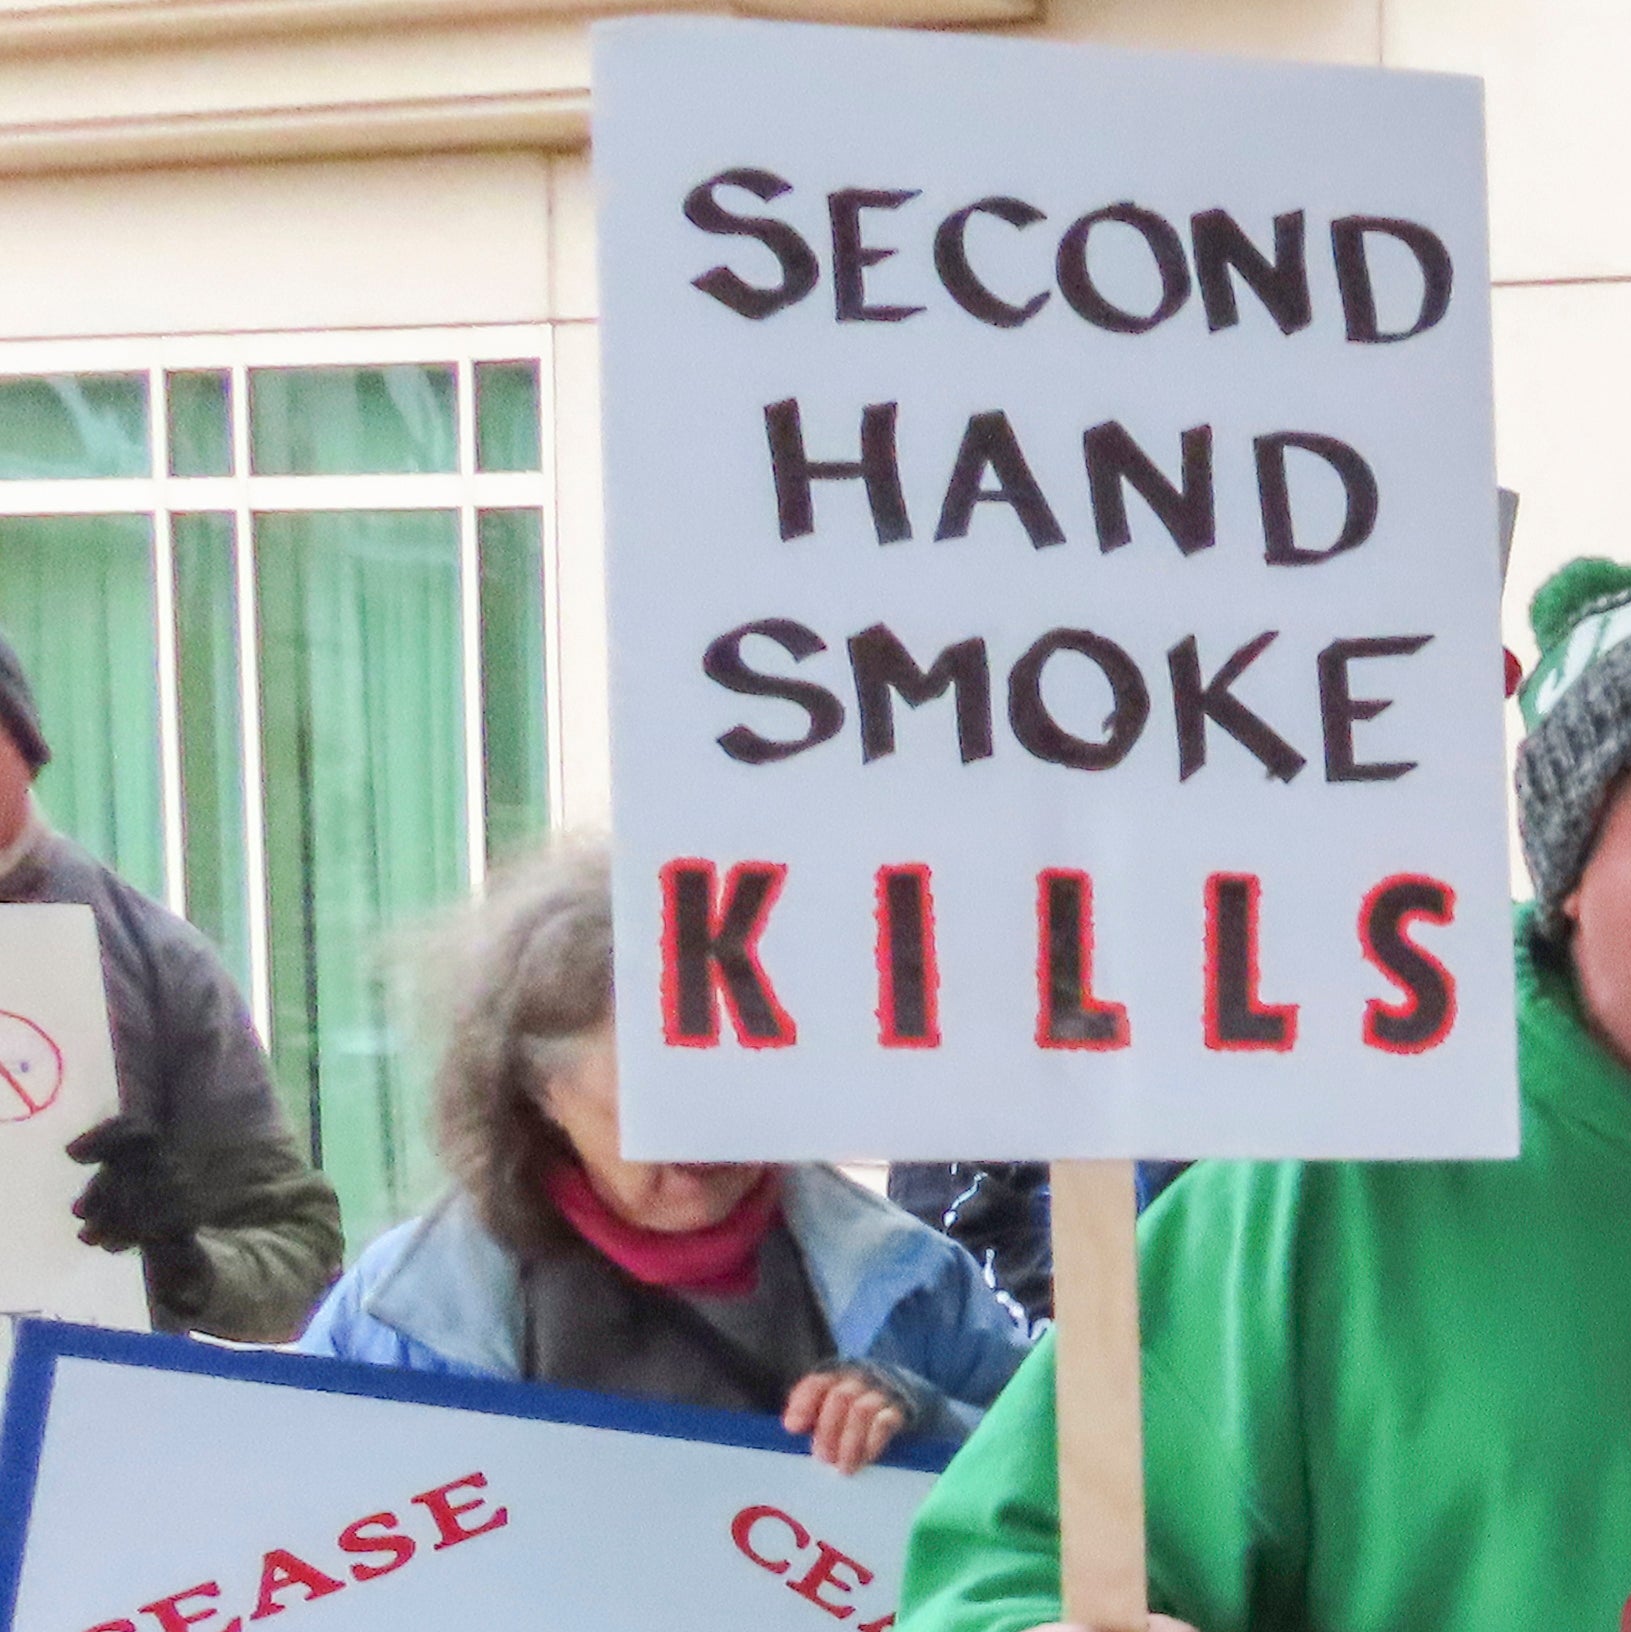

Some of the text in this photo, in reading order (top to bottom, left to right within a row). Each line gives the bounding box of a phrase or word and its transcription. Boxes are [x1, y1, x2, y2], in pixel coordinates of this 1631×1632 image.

[682, 167, 1453, 343] SECOND
[764, 398, 1379, 567] HAND
[702, 618, 1435, 784] SMOKE
[658, 857, 1457, 1056] KILLS
